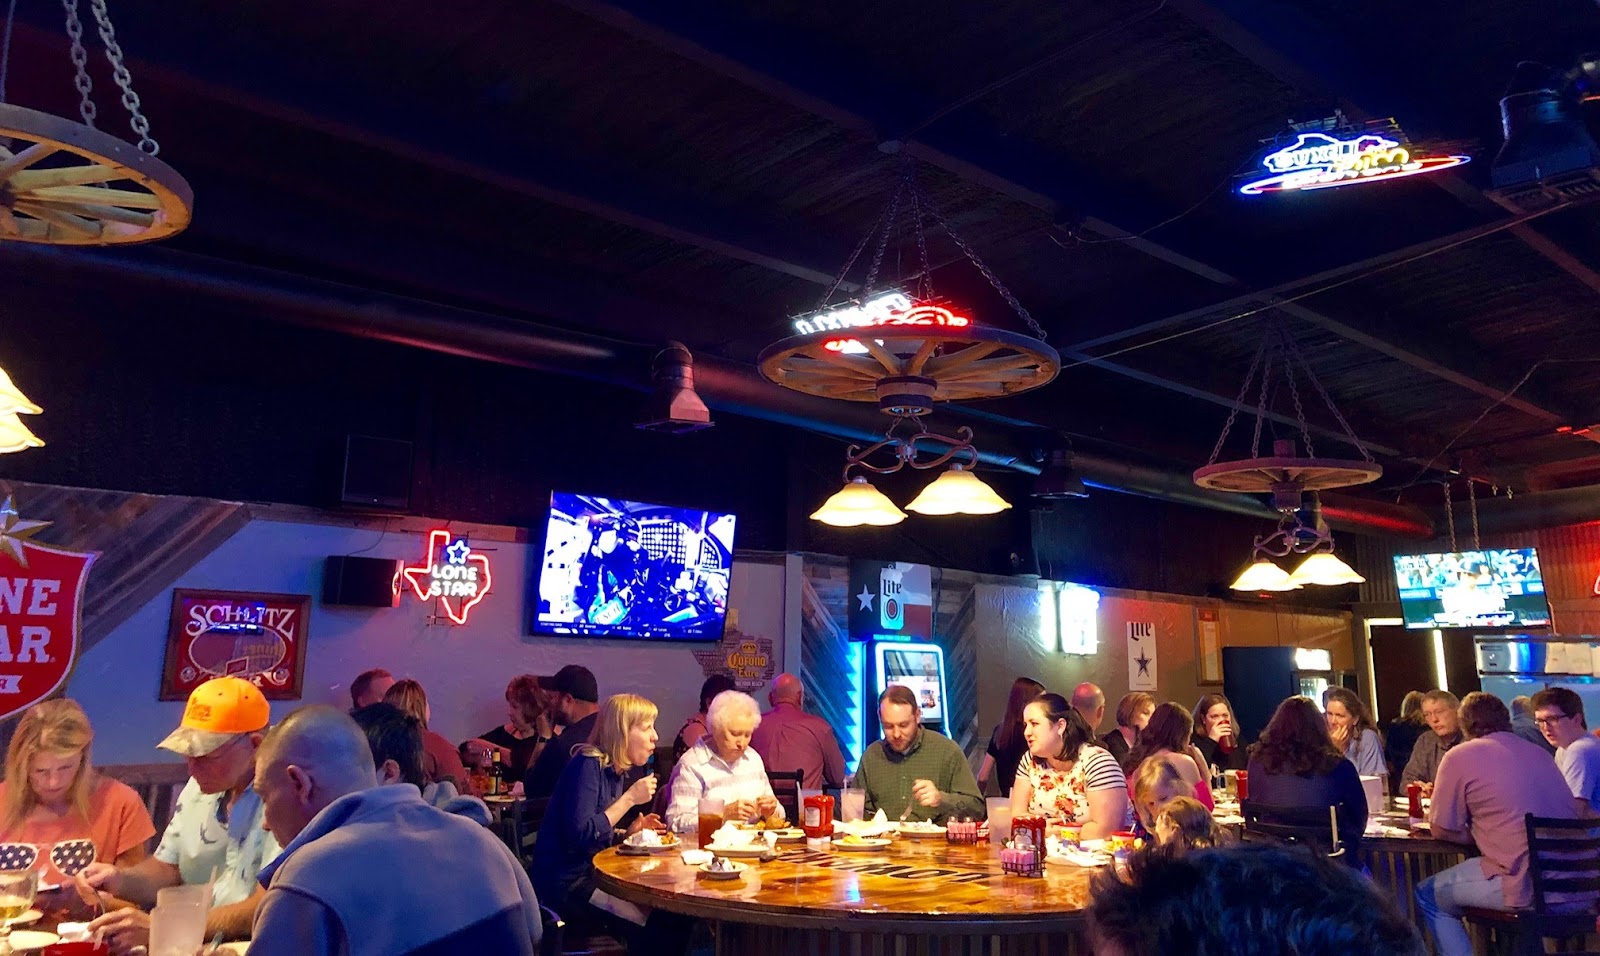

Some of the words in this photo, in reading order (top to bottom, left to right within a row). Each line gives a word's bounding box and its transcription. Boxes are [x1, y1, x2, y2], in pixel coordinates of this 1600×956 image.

[431, 564, 478, 580] LONE
[0, 577, 61, 615] NE
[430, 580, 478, 597] STAR
[883, 578, 901, 597] Lite
[185, 604, 296, 641] SCHLITZ
[727, 652, 766, 669] Corona
